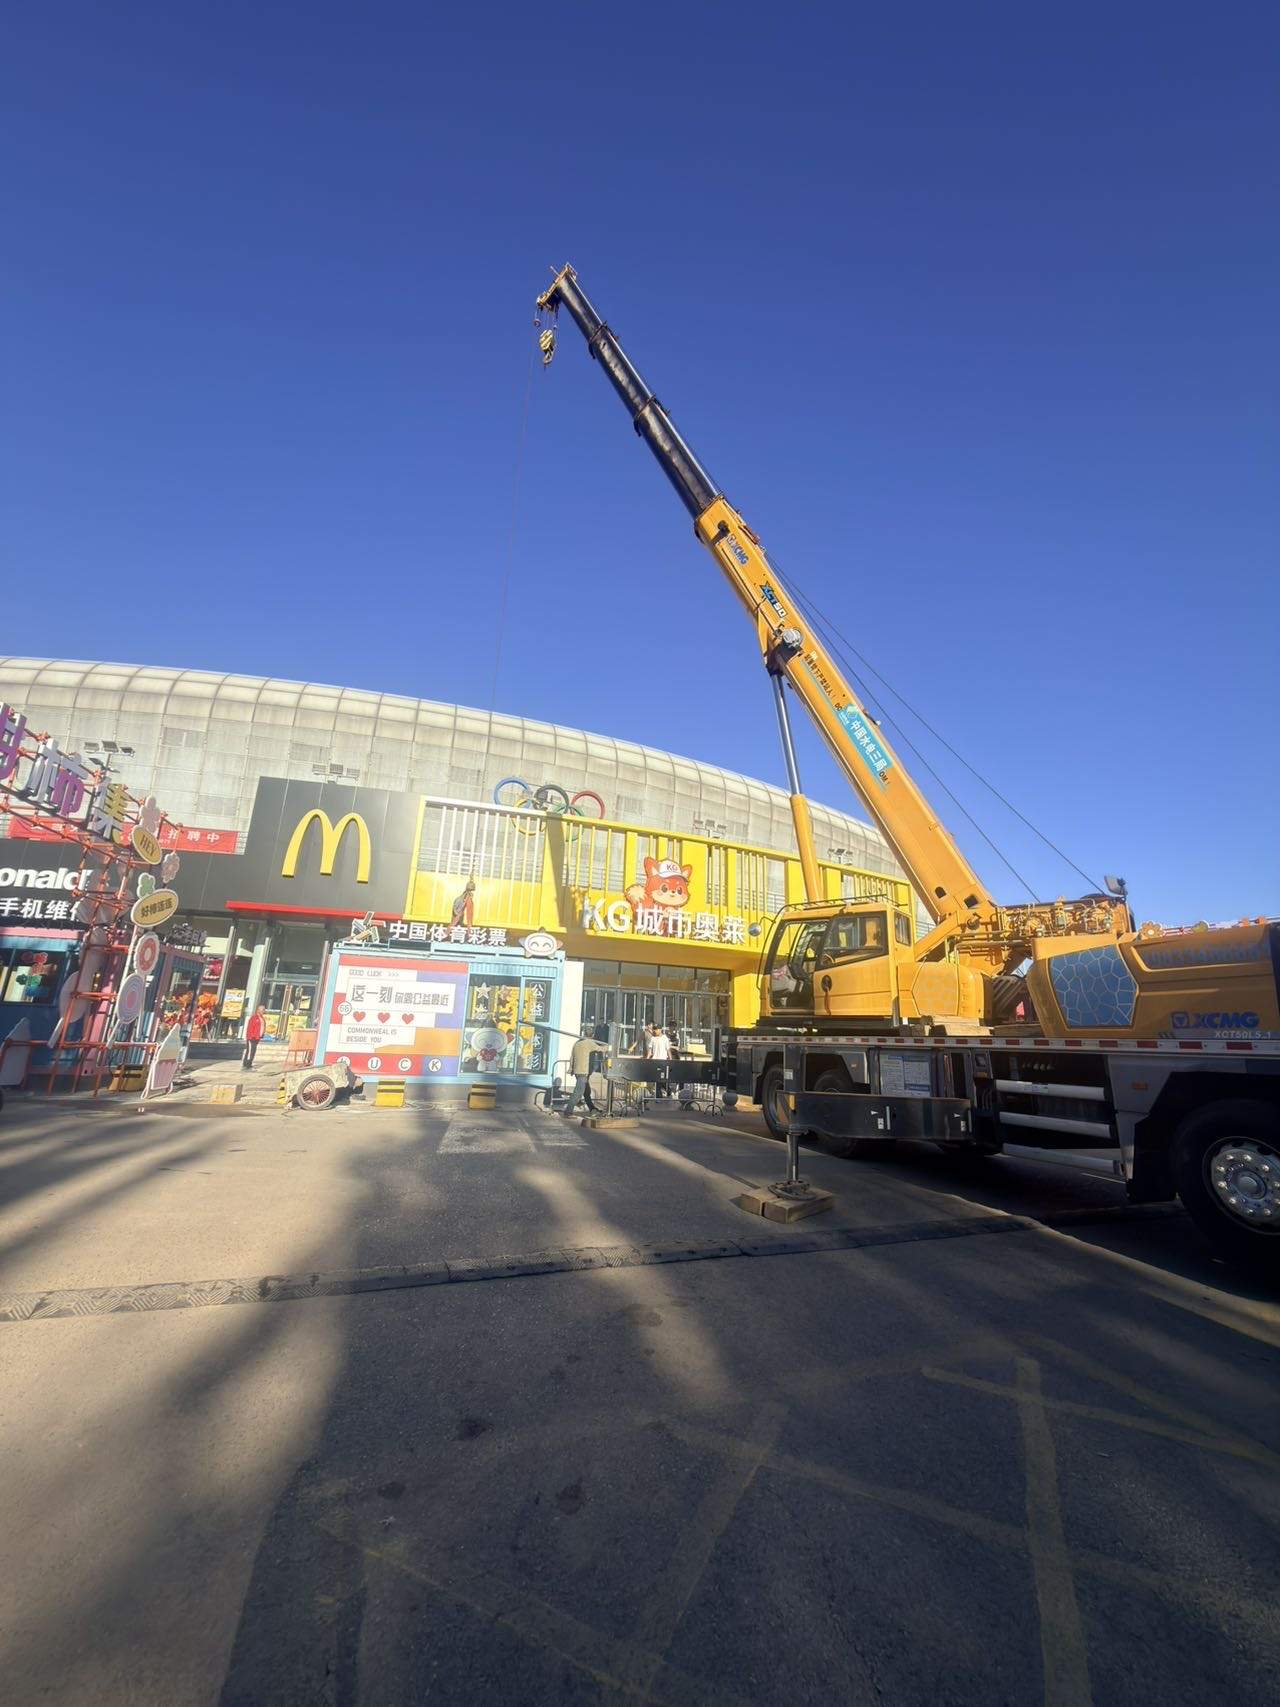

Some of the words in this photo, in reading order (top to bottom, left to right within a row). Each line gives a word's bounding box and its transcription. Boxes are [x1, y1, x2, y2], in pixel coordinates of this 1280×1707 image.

[848, 718, 888, 772] 中国水电三局
[139, 835, 157, 857] HEY
[389, 920, 507, 946] 中国体育彩票
[1192, 1012, 1260, 1028] XCMG
